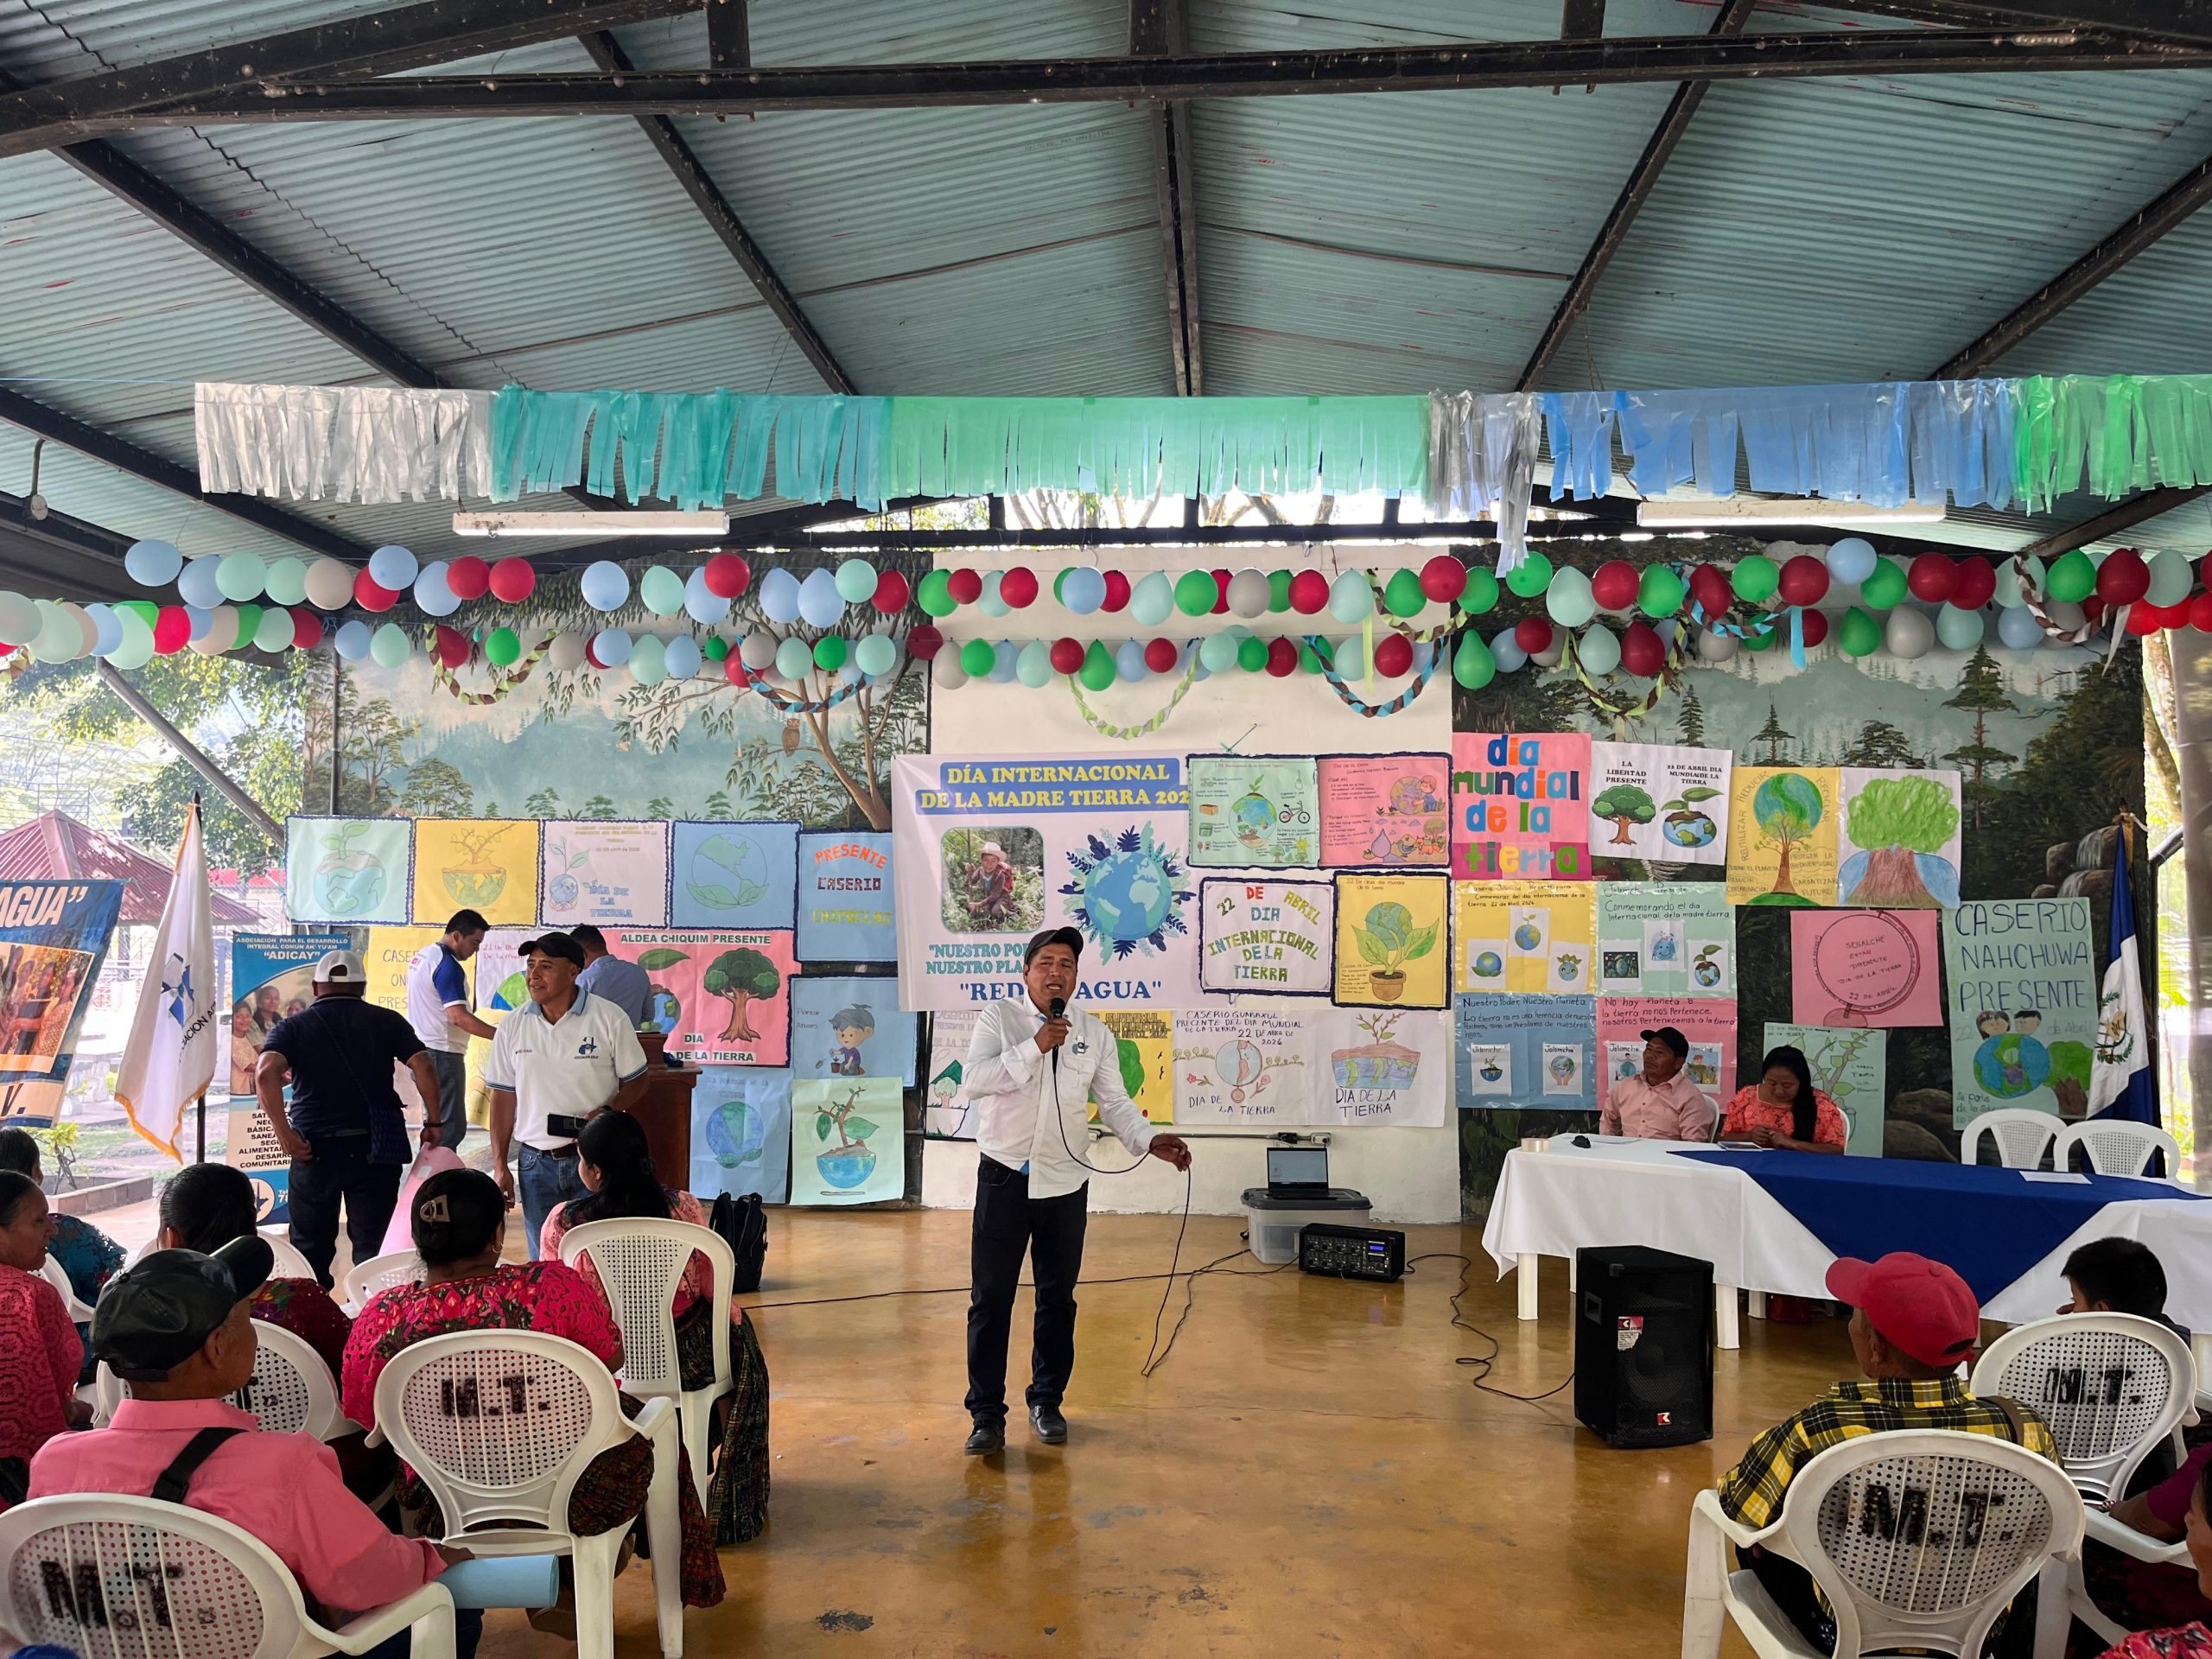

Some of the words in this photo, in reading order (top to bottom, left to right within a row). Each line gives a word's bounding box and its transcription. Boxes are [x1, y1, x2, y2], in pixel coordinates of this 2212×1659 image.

[1487, 734, 1541, 767] dia
[947, 766, 988, 785] DÍA
[992, 764, 1169, 784] INTERNACIONAL
[1606, 768, 1647, 778] LIBERTAD
[1453, 766, 1580, 801] mundial
[1605, 777, 1648, 785] PRESENTE
[920, 791, 950, 809] DE
[954, 791, 983, 808] LA
[988, 790, 1065, 808] MADRE
[1069, 788, 1151, 805] TIERRA
[1465, 799, 1507, 833] de
[1519, 802, 1551, 834] la
[1737, 809, 1750, 862] REUTILIZAR
[815, 842, 888, 870] PRESENTE
[1465, 842, 1578, 874] tierra
[817, 876, 881, 891] CASERIO
[1217, 897, 1236, 916] 22
[1246, 887, 1264, 899] DE
[1283, 891, 1320, 925] ABRIL
[1605, 899, 1675, 912] Conmemorando
[1251, 906, 1281, 921] DIA
[1608, 912, 1661, 922] Internacional
[1706, 909, 1730, 918] tierra
[1955, 901, 2087, 937] CASERIO
[621, 934, 657, 943] ALDEA
[713, 935, 771, 944] PRESENTE
[1207, 929, 1319, 961] INTERNACIONAL
[929, 944, 1001, 958] "NUESTRO
[1243, 945, 1262, 961] DE
[1264, 945, 1283, 960] LA
[1961, 941, 2088, 971] NAHCHUWA
[926, 960, 993, 975] NUESTRO
[1233, 964, 1287, 982] TIERRA
[1463, 996, 1497, 1008] Nuestro
[1522, 995, 1554, 1005] Nuestro
[1605, 997, 1617, 1007] No
[1623, 996, 1639, 1009] hay
[1848, 992, 1859, 1001] 22
[1960, 979, 2087, 1012] PRESENTE
[1186, 1010, 1230, 1019] CASERIO
[1464, 1011, 1477, 1022] La
[1535, 1011, 1562, 1020] herencia
[1602, 1008, 1610, 1018] la
[1613, 1008, 1639, 1018] tierra
[1639, 1016, 1696, 1025] Pertenecemos
[1176, 1019, 1221, 1028] PRECENTE
[1262, 1020, 1304, 1028] MUNDIAL
[1955, 1026, 1973, 1042] 22
[2048, 1020, 2062, 1036] de
[2065, 1020, 2092, 1035] Abril
[684, 1034, 703, 1043] DIA
[1237, 1028, 1253, 1038] 22
[677, 1052, 691, 1060] DE
[695, 1052, 708, 1060] LA
[713, 1052, 754, 1061] TIERRA
[1211, 1095, 1223, 1104] DE
[1336, 1088, 1355, 1103] DIA
[1359, 1089, 1375, 1103] DE
[1376, 1089, 1396, 1103] LA
[1240, 1105, 1275, 1116] TIERRA
[1338, 1103, 1392, 1118] TIERRA
[2042, 1368, 2141, 1405] M.T.
[442, 1376, 550, 1418] M.T.
[1862, 1484, 2014, 1547] M.T.
